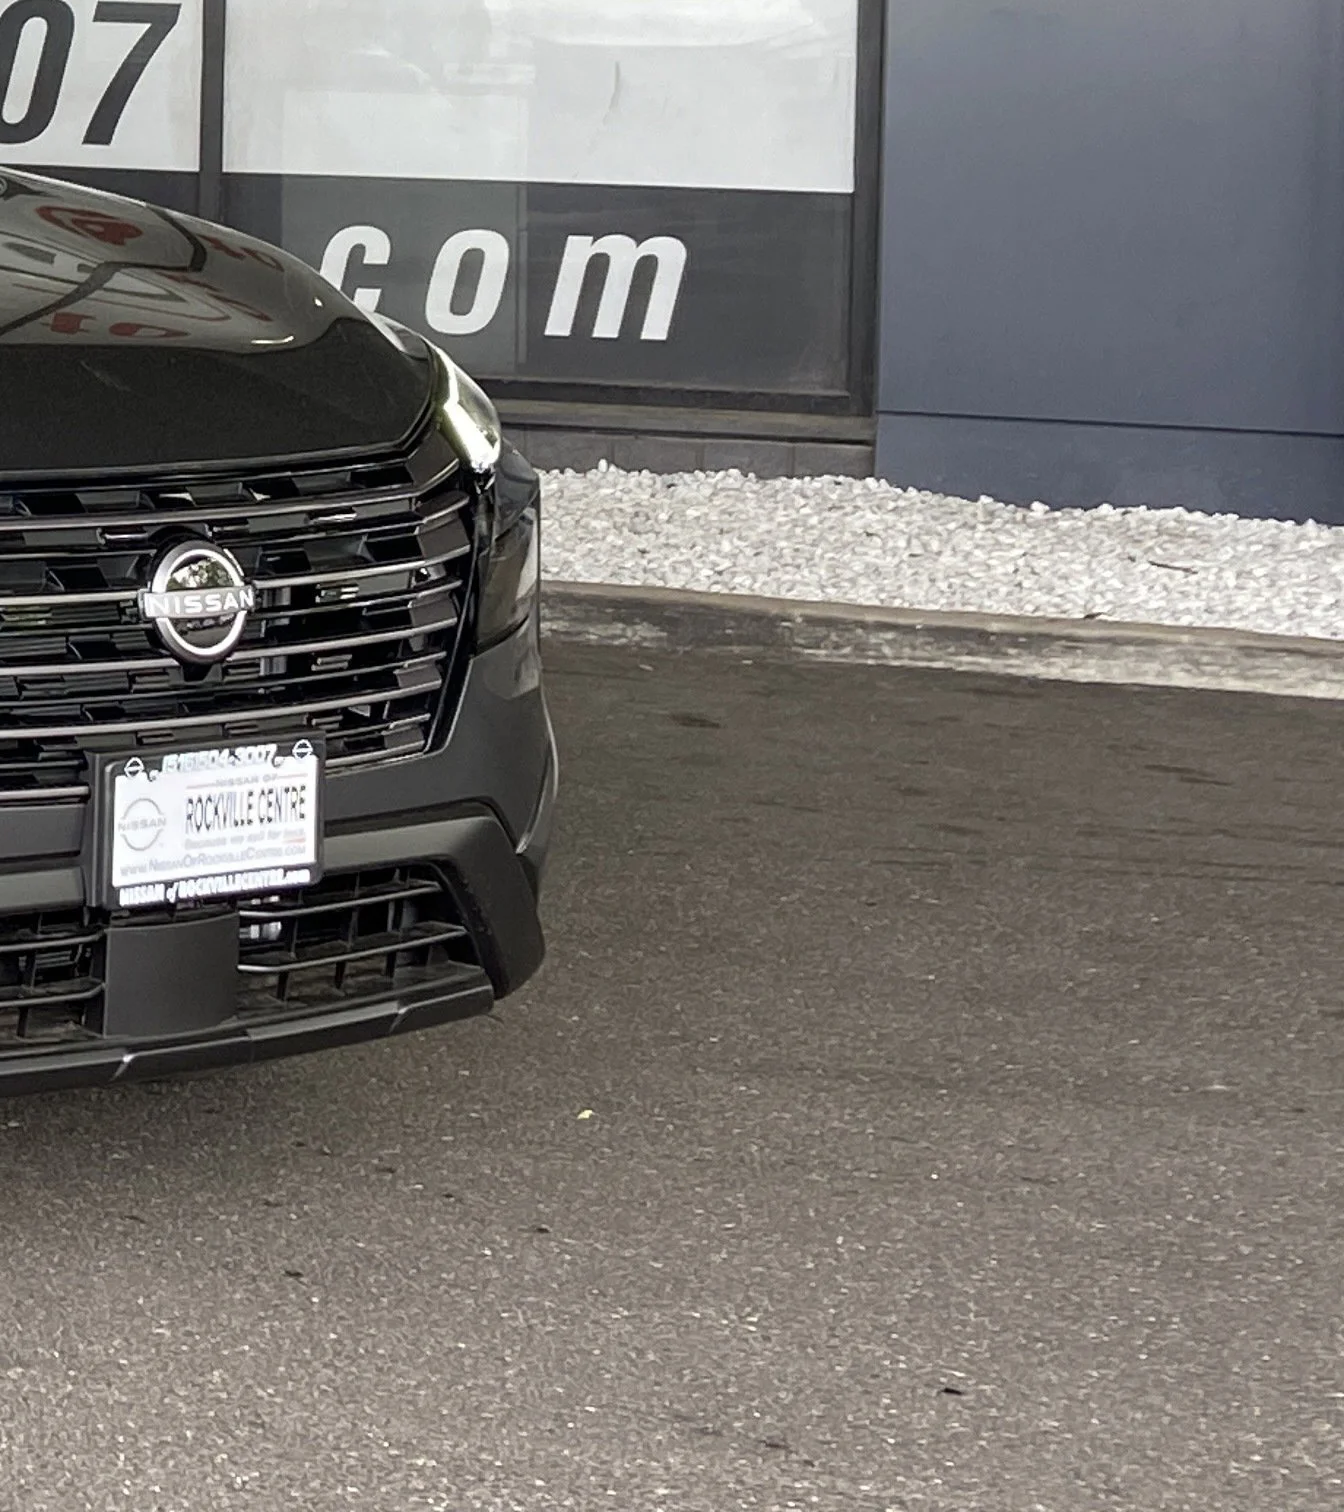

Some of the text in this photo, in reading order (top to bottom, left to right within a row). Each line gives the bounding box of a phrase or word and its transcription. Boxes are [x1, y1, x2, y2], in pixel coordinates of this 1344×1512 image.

[144, 589, 254, 617] NISSAN
[185, 784, 306, 835] ROCKVILLE CENTRE
[118, 817, 167, 832] NISSAN
